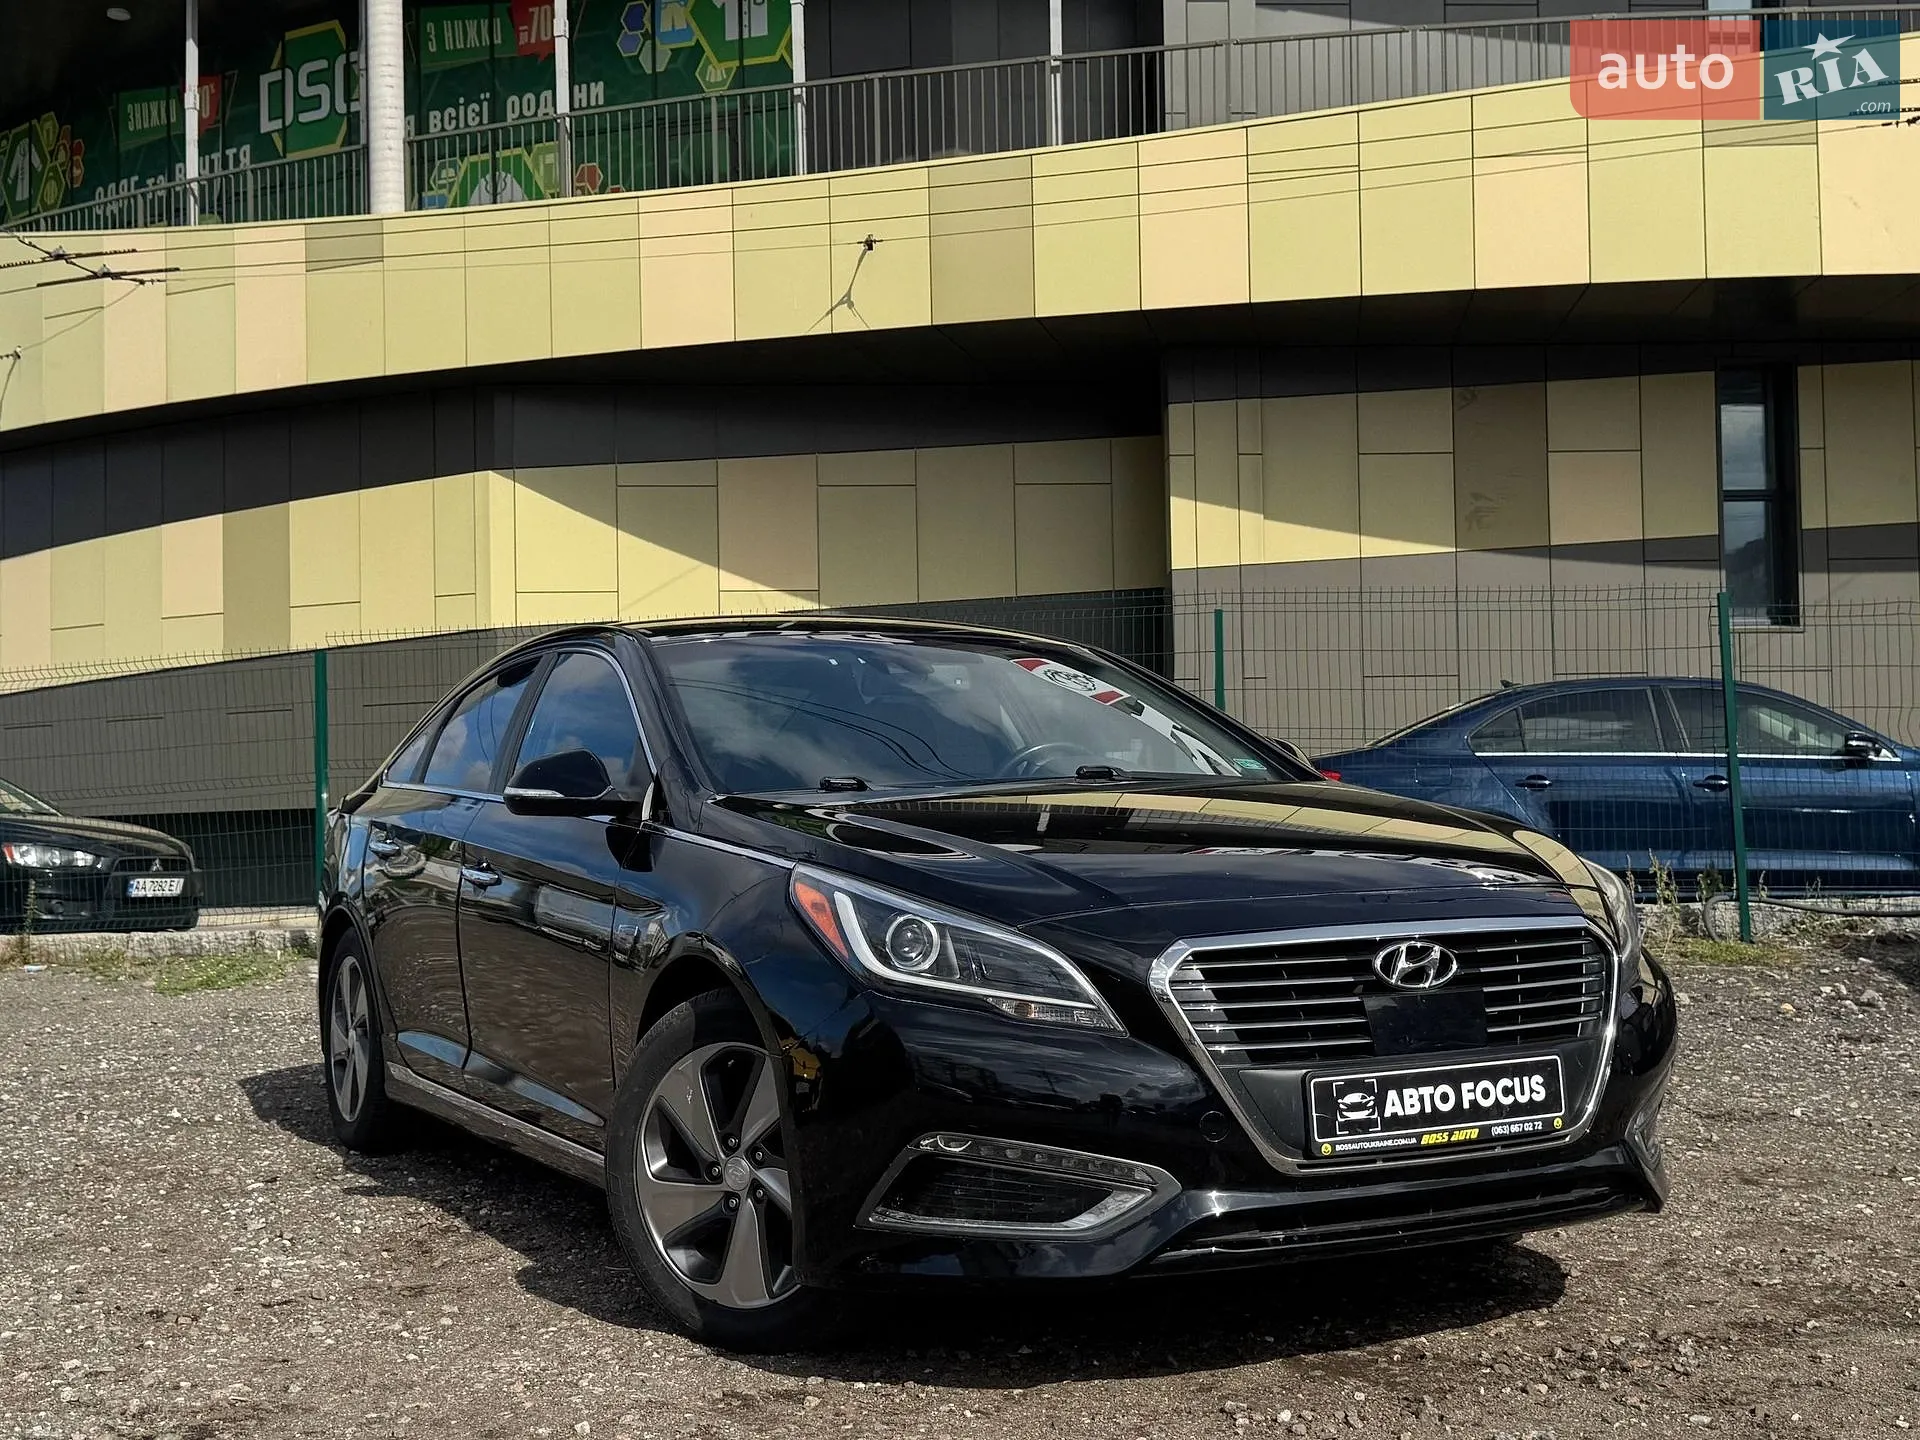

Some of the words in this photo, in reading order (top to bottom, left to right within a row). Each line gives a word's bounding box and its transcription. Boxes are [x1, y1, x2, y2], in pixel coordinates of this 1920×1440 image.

[1461, 1074, 1546, 1110] FOCUS
[1420, 1131, 1449, 1145] BOSS
[1450, 1128, 1479, 1142] AUTO
